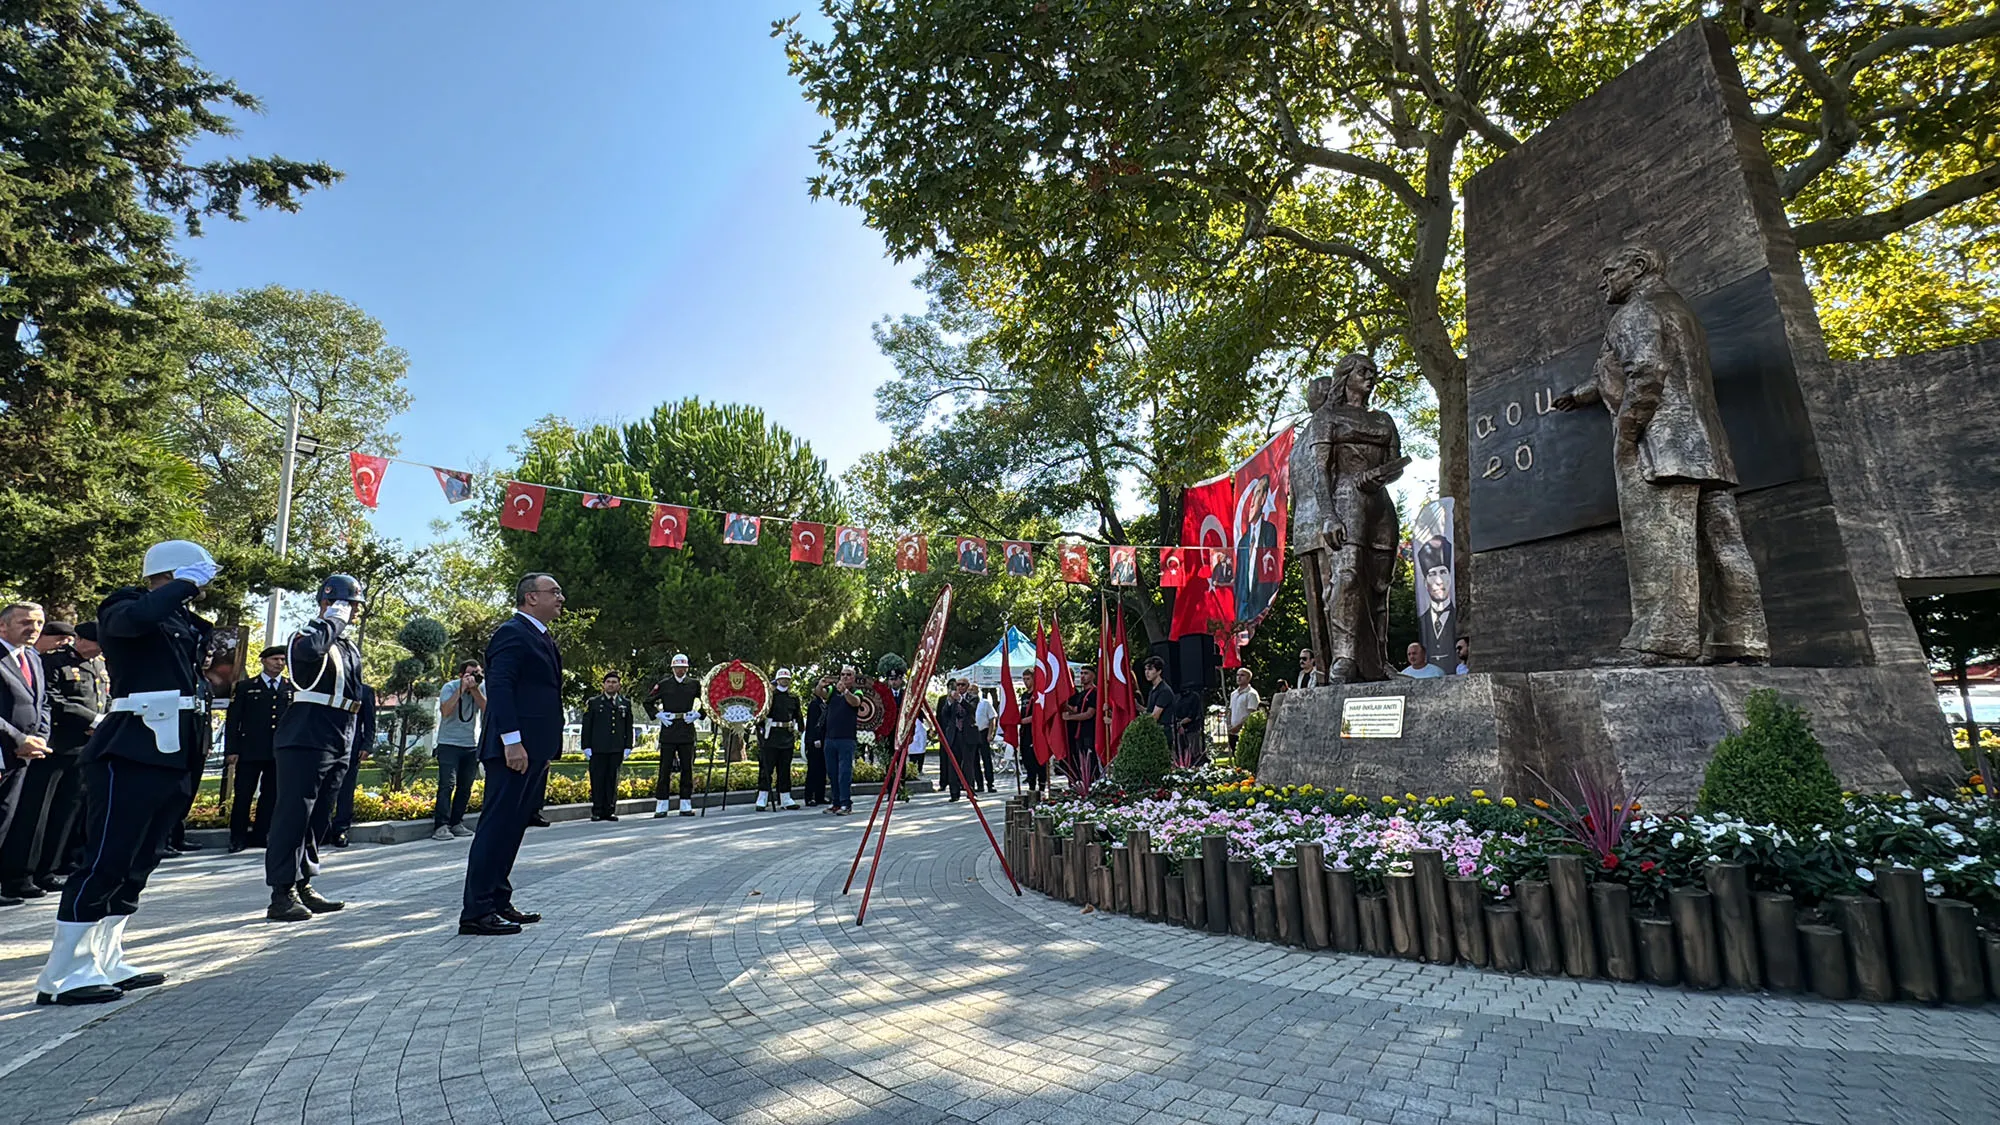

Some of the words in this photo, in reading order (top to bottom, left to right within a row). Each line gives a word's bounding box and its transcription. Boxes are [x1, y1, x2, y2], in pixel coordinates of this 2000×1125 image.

[1476, 415, 1497, 440] a
[1506, 402, 1521, 425] o
[1482, 456, 1507, 480] e
